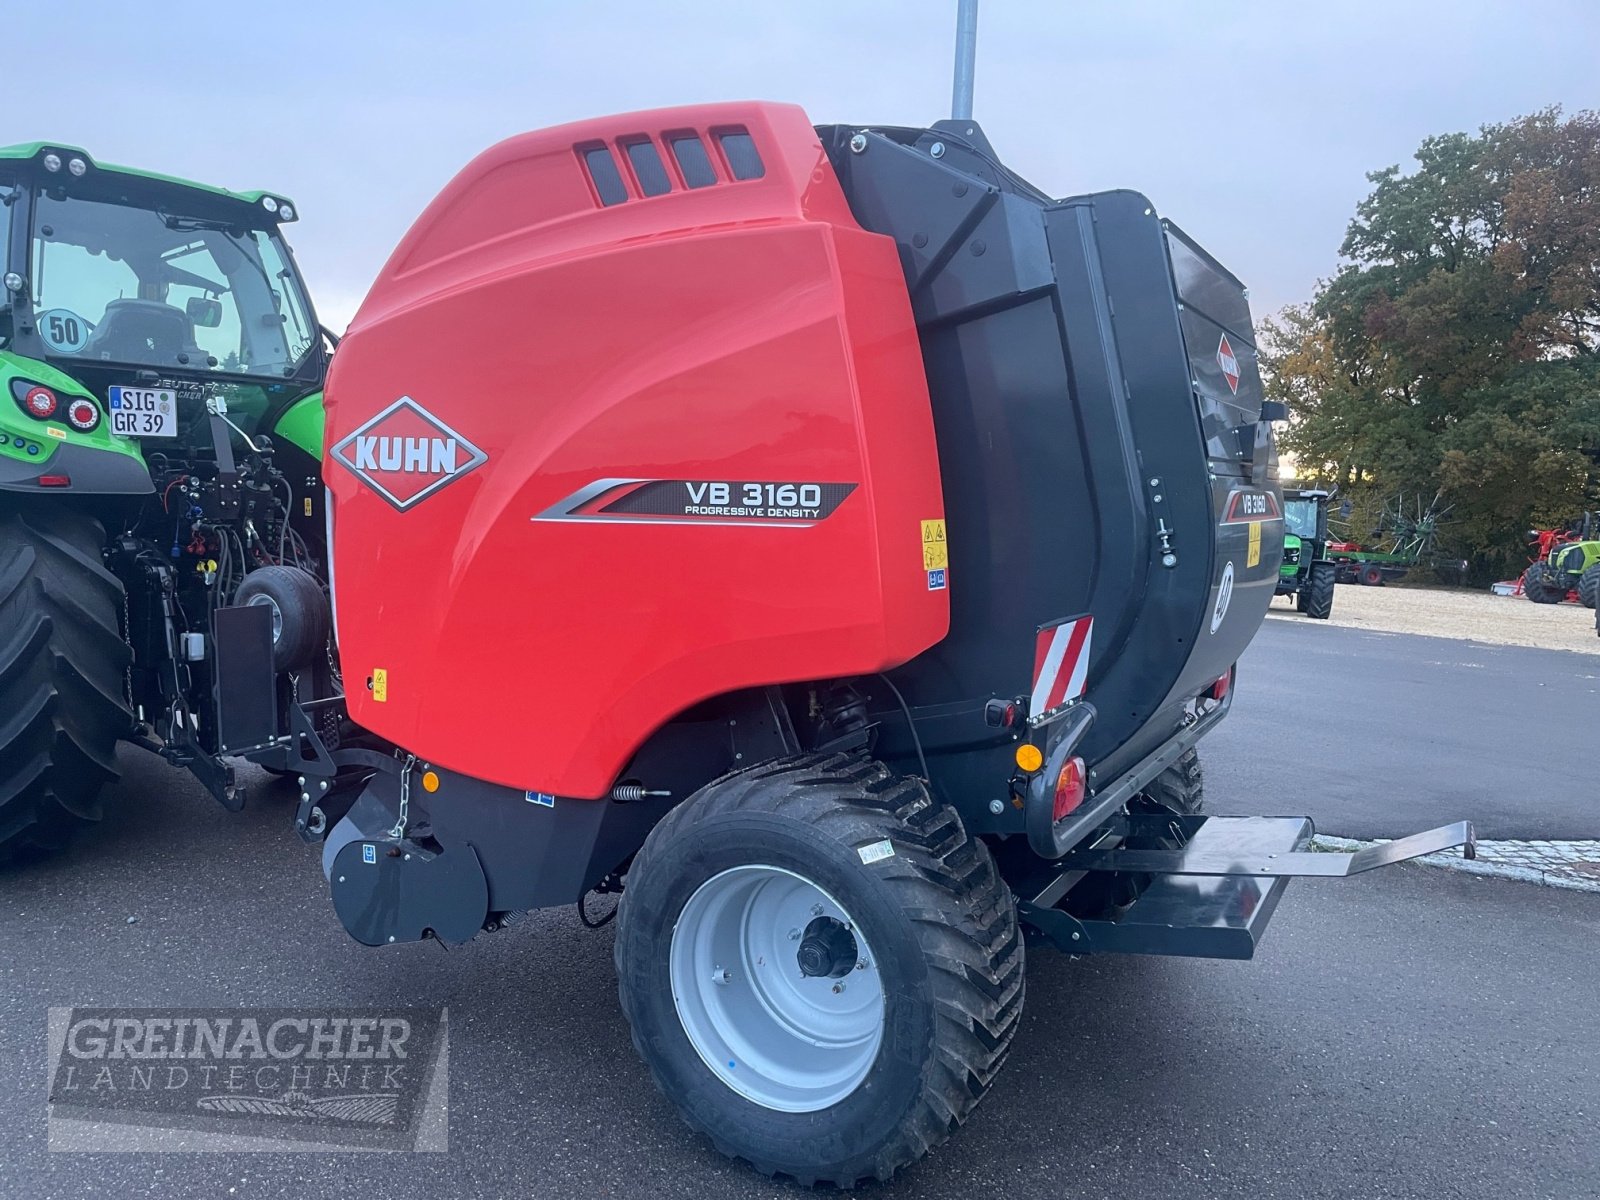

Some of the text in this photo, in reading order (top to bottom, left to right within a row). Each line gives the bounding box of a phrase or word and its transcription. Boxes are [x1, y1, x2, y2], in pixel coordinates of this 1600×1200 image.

[50, 316, 79, 345] 50
[122, 391, 155, 411] SIG
[114, 412, 164, 433] GR 39
[355, 435, 456, 474] KUHN
[685, 482, 821, 507] VB 3160
[1242, 494, 1266, 513] VB 3160
[685, 505, 820, 518] PROGRESSIVE DENSITY
